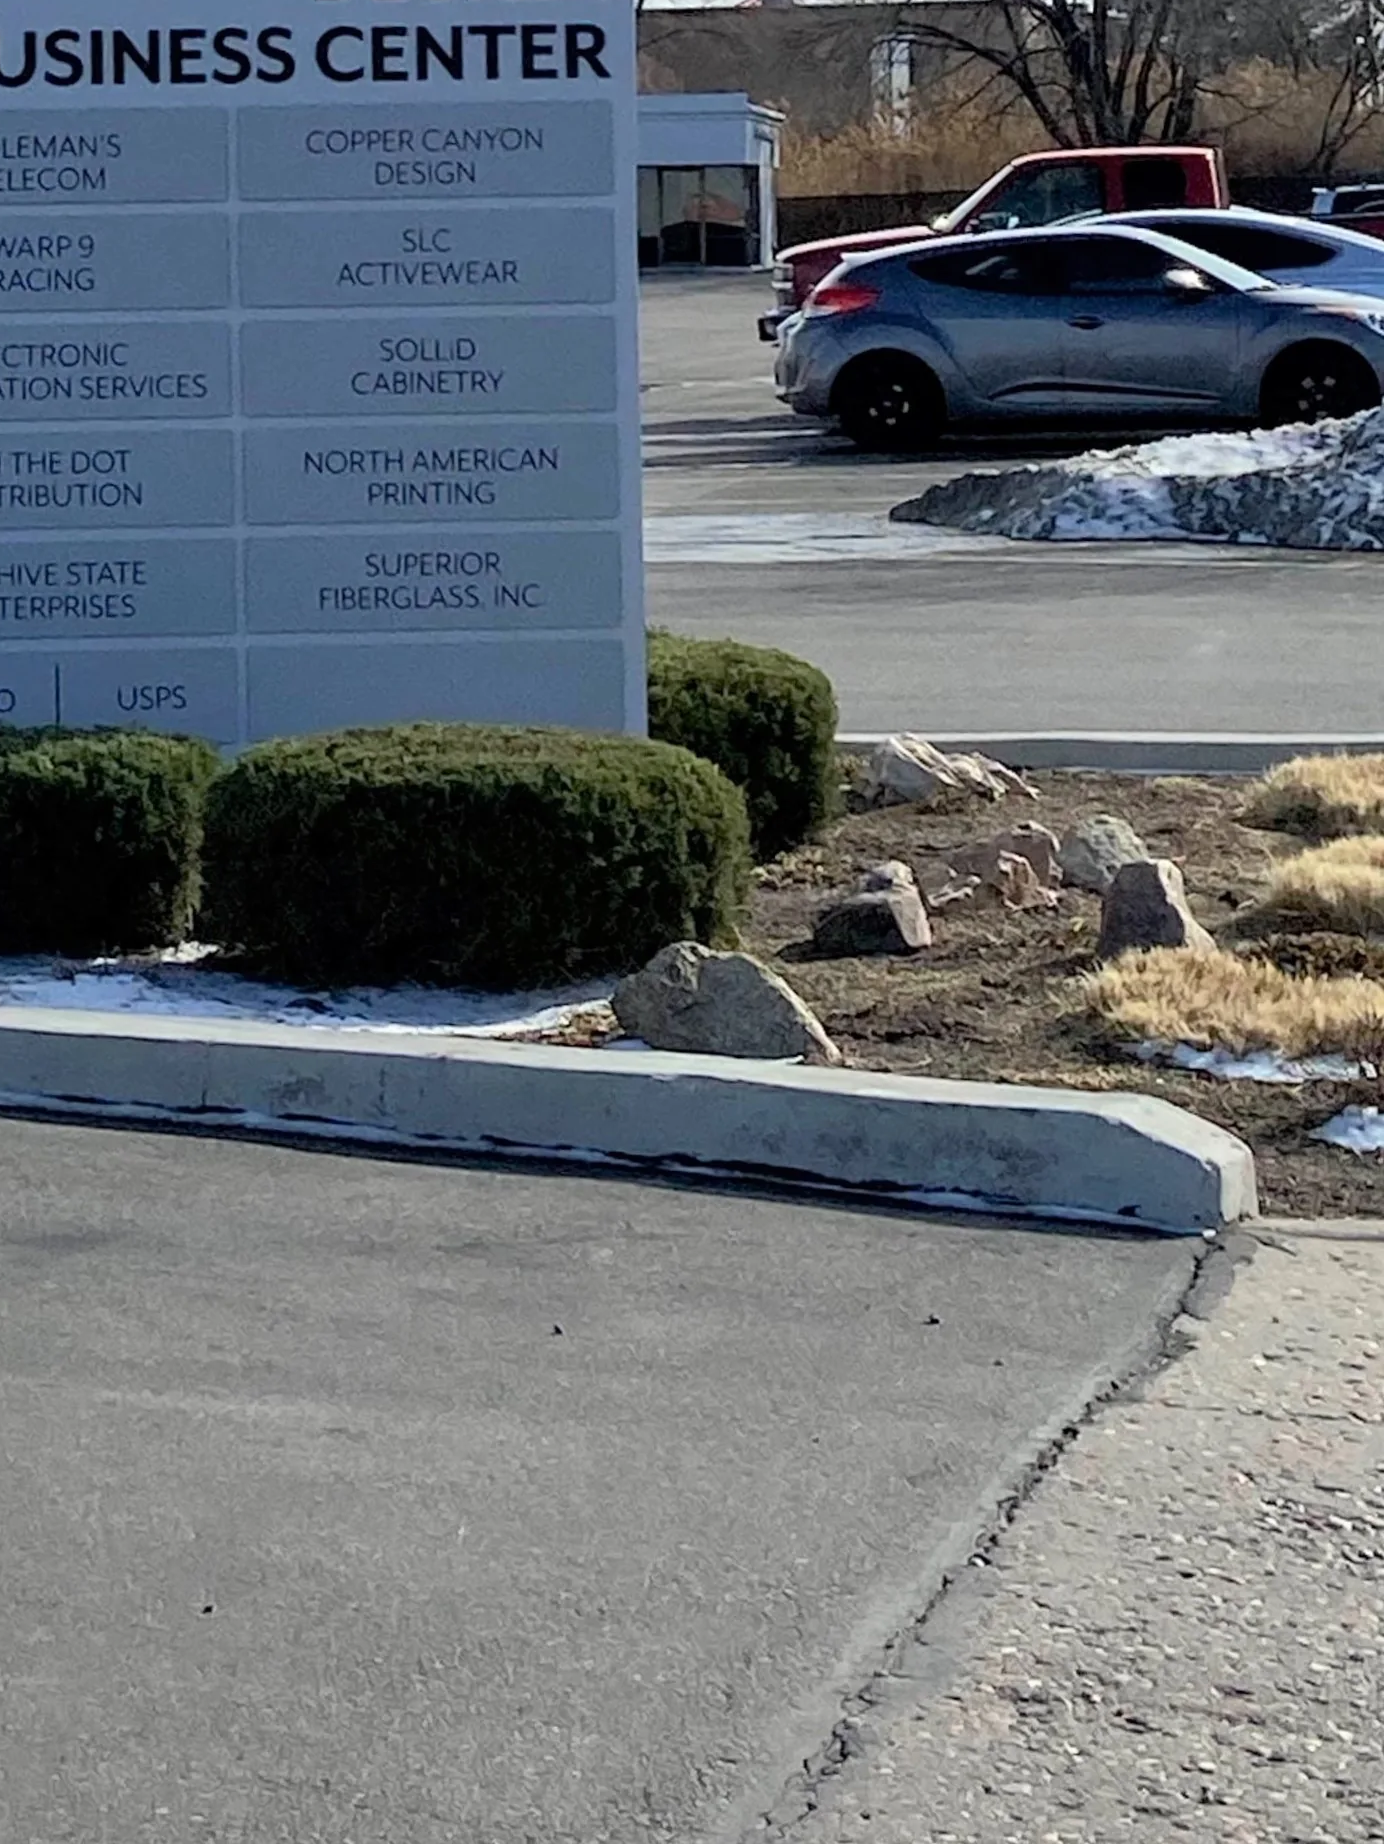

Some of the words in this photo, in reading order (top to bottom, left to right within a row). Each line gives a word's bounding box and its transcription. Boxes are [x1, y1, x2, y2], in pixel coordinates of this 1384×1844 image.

[315, 23, 611, 82] CENTER
[305, 128, 415, 155] COPPER
[421, 127, 544, 153] CANYON
[374, 160, 476, 186] DESIGN
[77, 234, 95, 259] 9
[402, 227, 452, 254] SLC
[336, 259, 519, 287] ACTIVEWEAR
[79, 373, 208, 401] SERVICES
[350, 369, 504, 396] CABINETRY
[10, 450, 62, 476] THE
[70, 449, 132, 475] DOT
[303, 448, 403, 475] NORTH
[411, 447, 558, 473] AMERICAN
[367, 480, 496, 506] PRINTING
[66, 560, 147, 587] STATE
[364, 551, 502, 578] SUPERIOR
[116, 684, 187, 712] USPS
